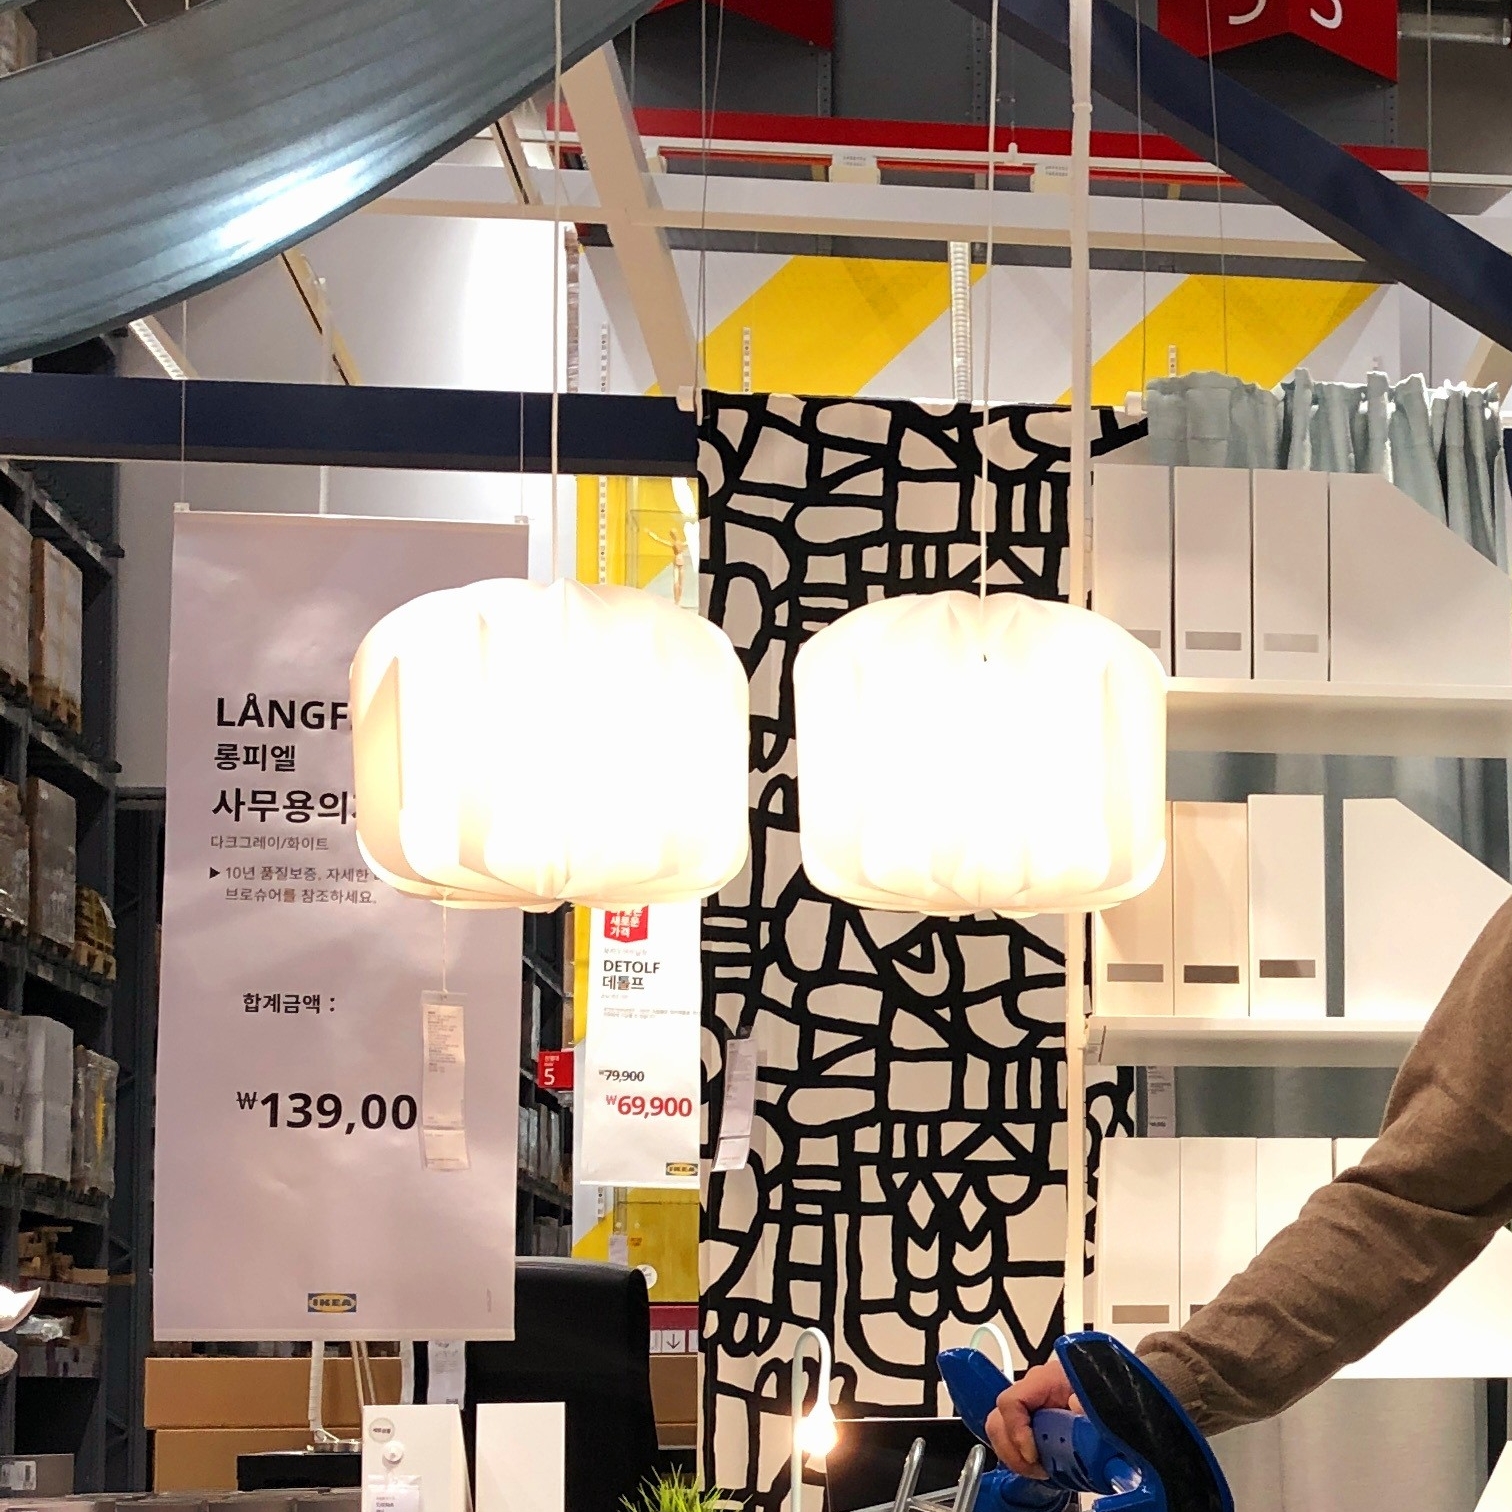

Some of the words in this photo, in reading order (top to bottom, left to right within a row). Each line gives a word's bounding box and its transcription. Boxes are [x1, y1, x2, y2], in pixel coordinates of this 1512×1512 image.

[216, 692, 352, 731] LÅNGF
[214, 743, 296, 772] 롱피엘
[211, 787, 356, 825] 사무용의
[210, 835, 329, 851] 다크그레이/화이트
[225, 866, 256, 880] 10년
[326, 868, 370, 882] 자세한
[225, 887, 296, 903] 브로슈어를
[301, 889, 377, 904] 참조하세요.
[603, 959, 661, 975] DETOLF
[242, 992, 321, 1014] 합계금액
[543, 1067, 556, 1086] 5
[606, 1094, 693, 1120] ₩69,900
[667, 1164, 697, 1174] IKEA
[309, 1296, 355, 1310] IKEA
